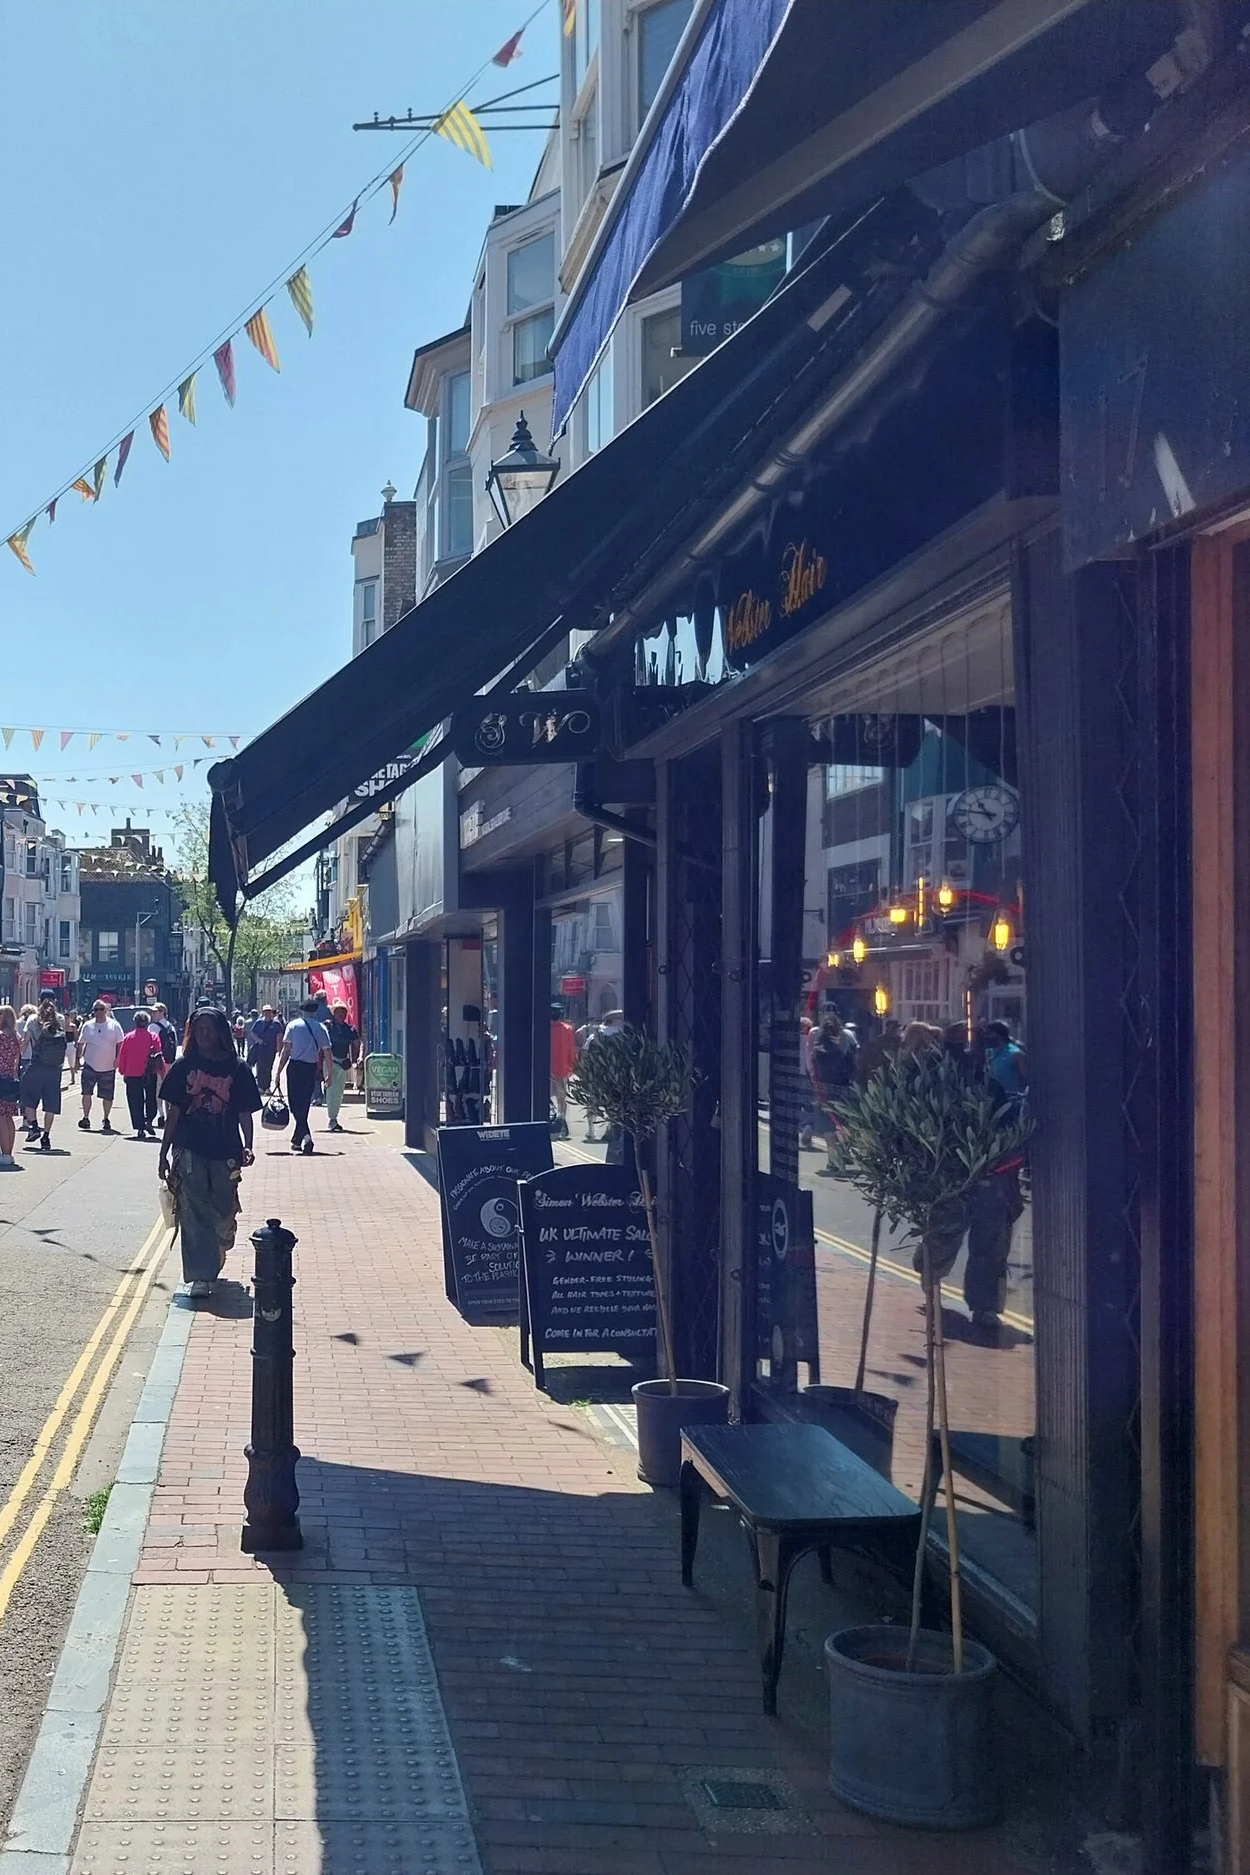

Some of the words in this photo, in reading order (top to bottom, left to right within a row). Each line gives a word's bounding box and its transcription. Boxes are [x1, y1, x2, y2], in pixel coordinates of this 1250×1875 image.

[690, 320, 716, 336] five
[371, 1066, 399, 1074] VEGAN
[533, 1189, 573, 1211] Simon
[539, 1227, 559, 1243] UK
[563, 1226, 623, 1243] ULTIMATE
[480, 1241, 488, 1251] A
[473, 1271, 491, 1282] THE
[551, 1290, 565, 1300] ALL
[566, 1290, 588, 1299] HAIR
[551, 1305, 570, 1315] AND
[545, 1327, 571, 1339] COME
[572, 1328, 585, 1338] IN
